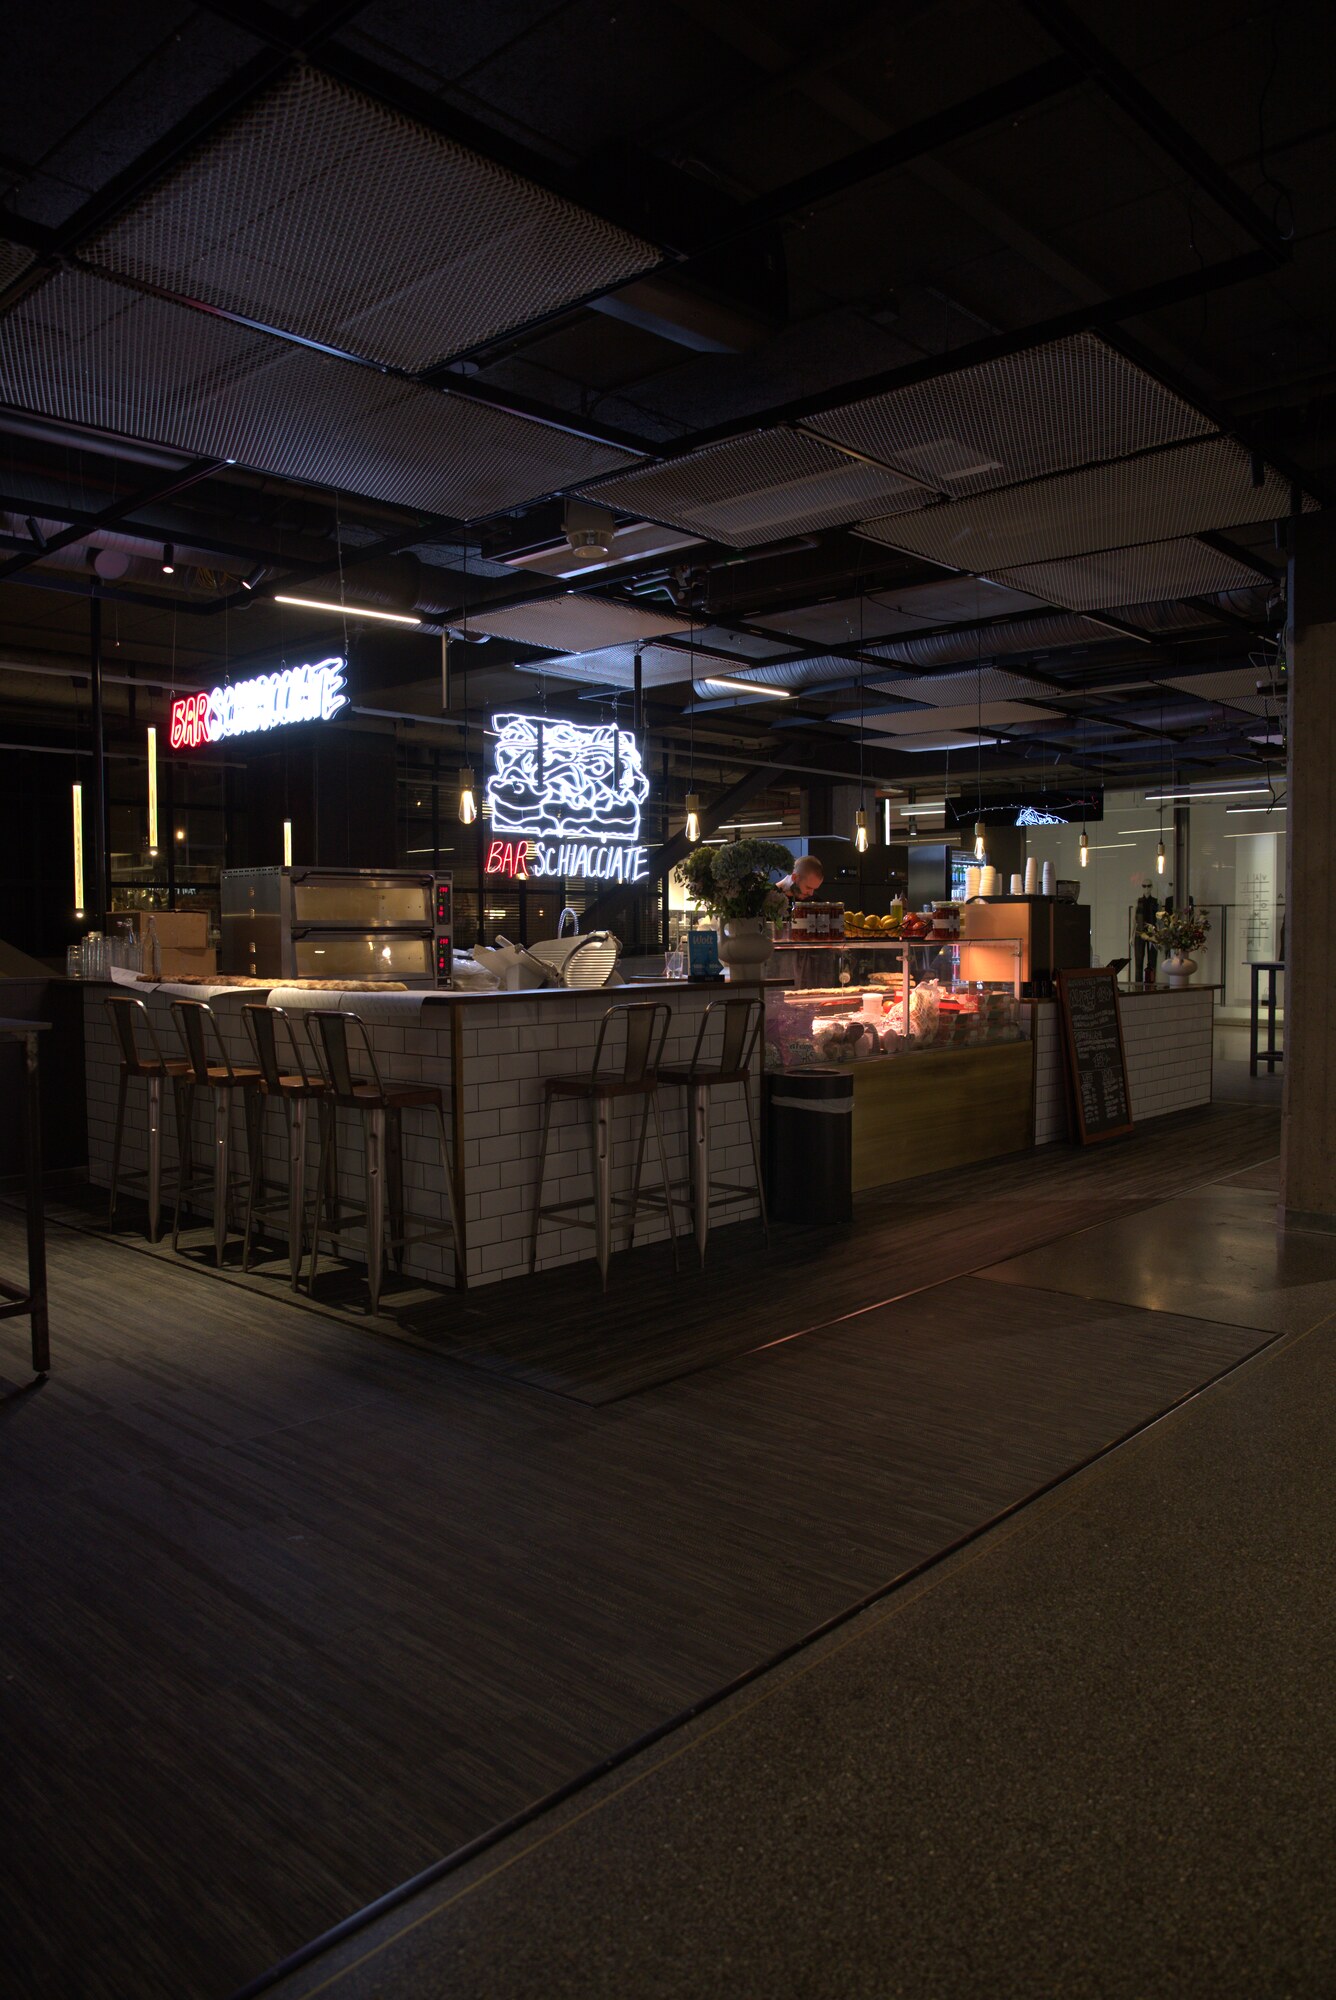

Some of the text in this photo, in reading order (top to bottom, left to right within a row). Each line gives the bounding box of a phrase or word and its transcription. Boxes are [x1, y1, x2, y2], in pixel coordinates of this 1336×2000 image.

[171, 692, 211, 749] BAR
[486, 840, 650, 884] BAR SCHIACCIATE
[692, 935, 714, 945] Wolt
